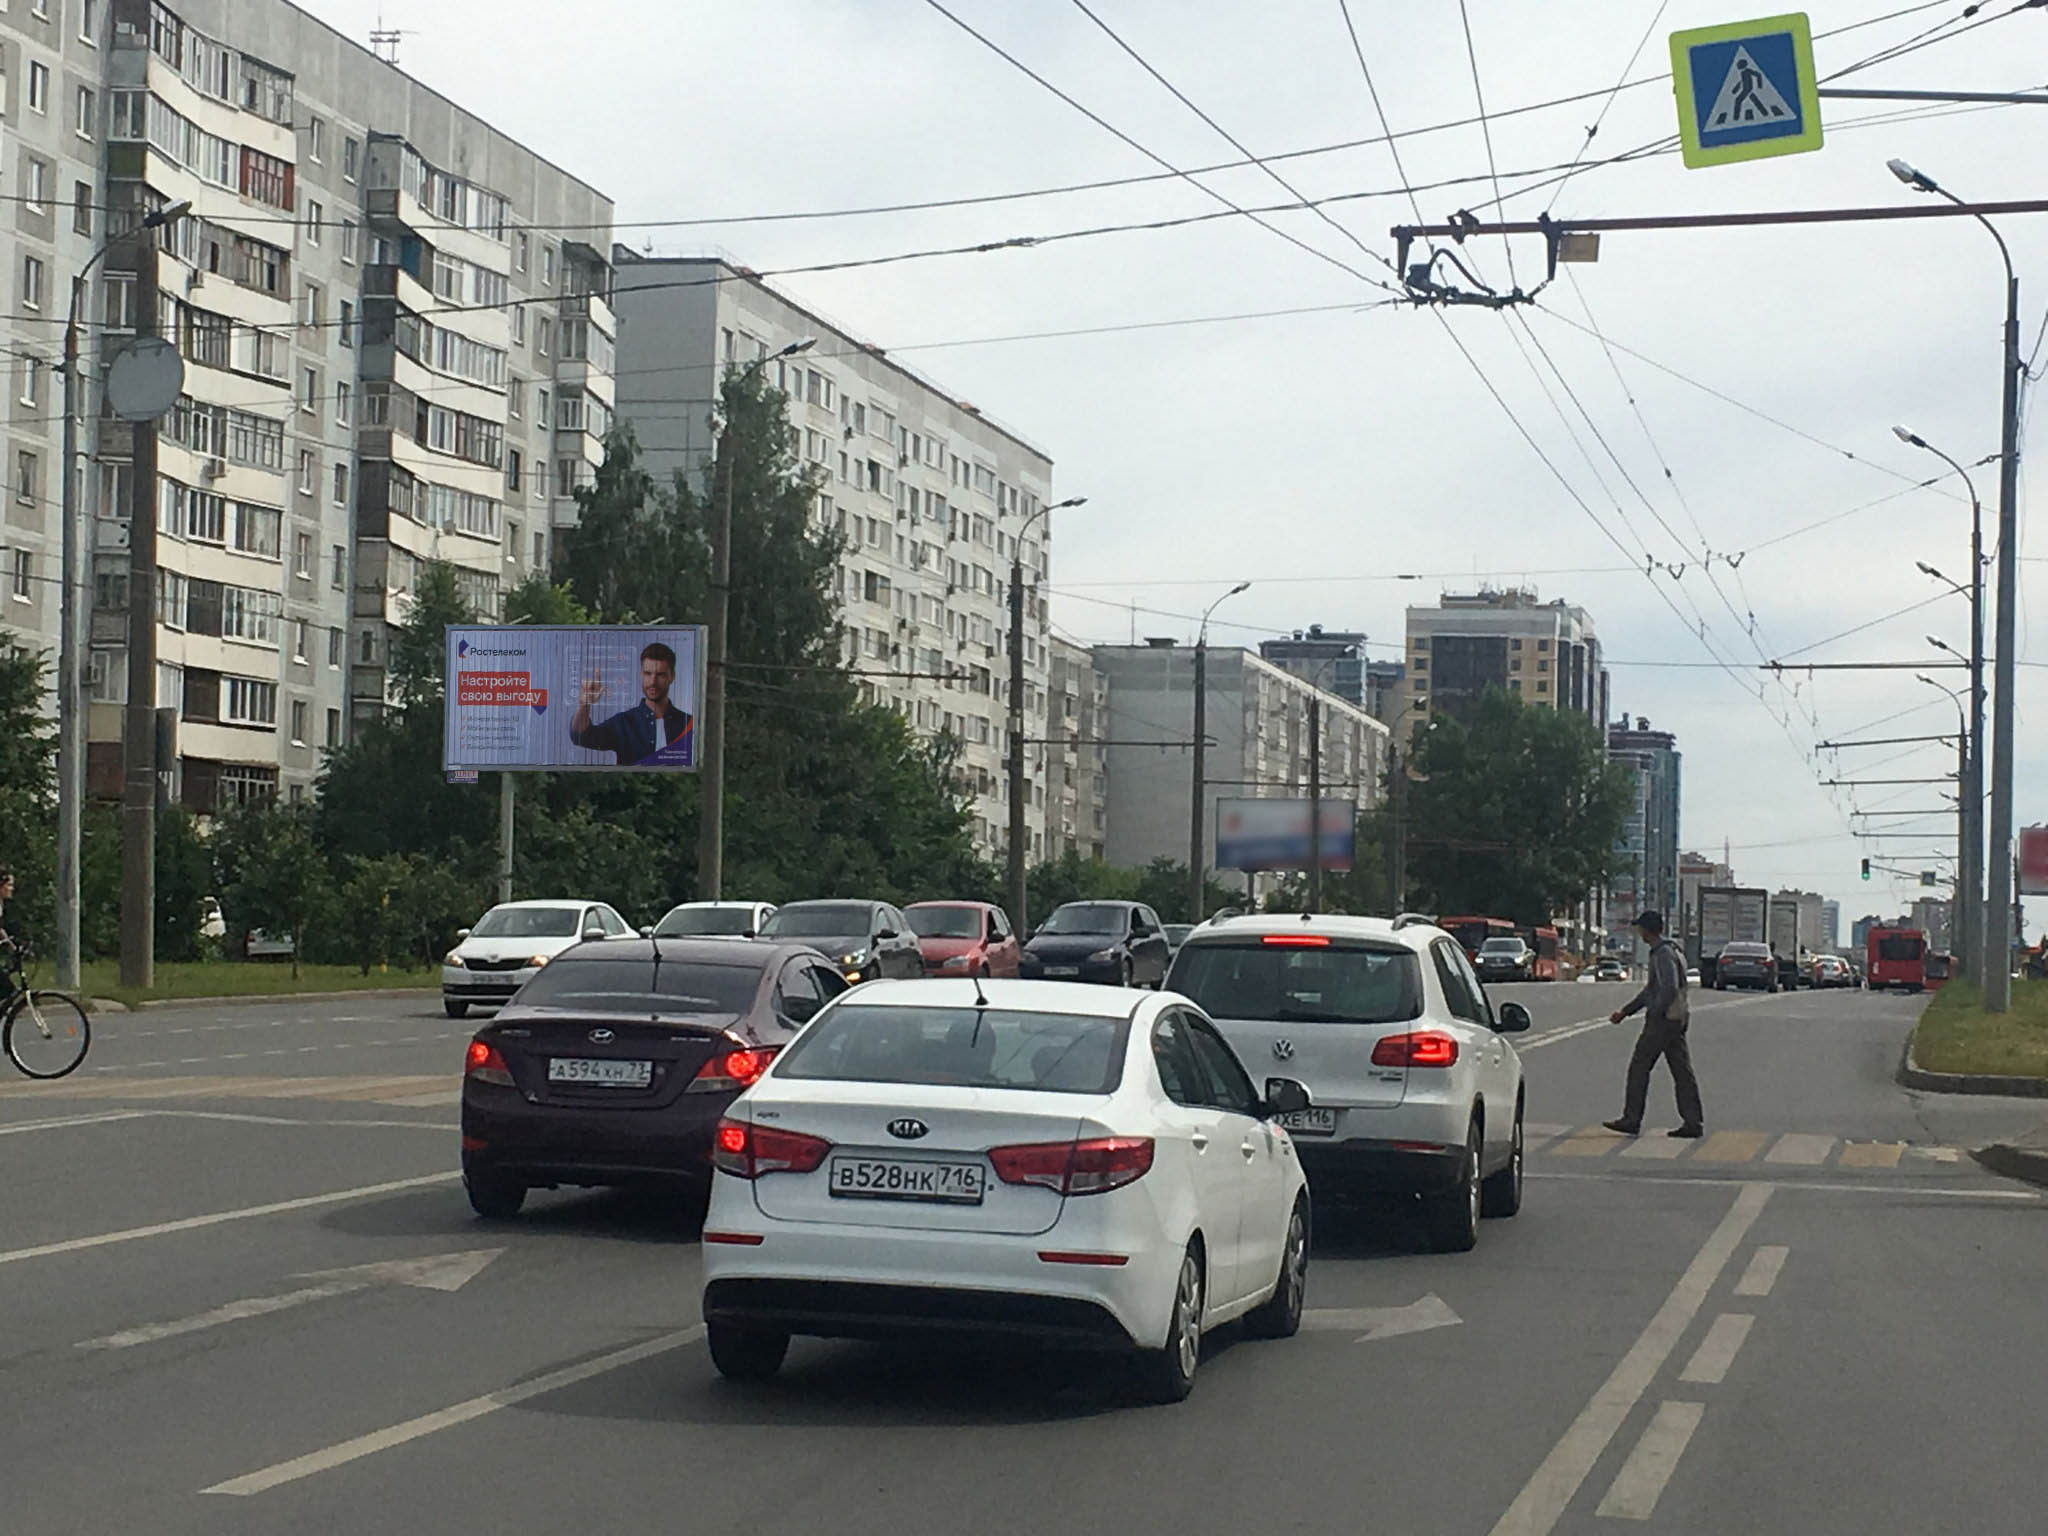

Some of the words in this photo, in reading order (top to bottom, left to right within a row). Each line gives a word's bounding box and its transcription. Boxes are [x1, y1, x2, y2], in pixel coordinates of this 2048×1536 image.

[470, 647, 527, 656] Ростелеком
[460, 674, 527, 688] Настройте
[461, 691, 493, 701] свою
[496, 691, 542, 704] выгоду
[893, 1121, 922, 1135] KIA
